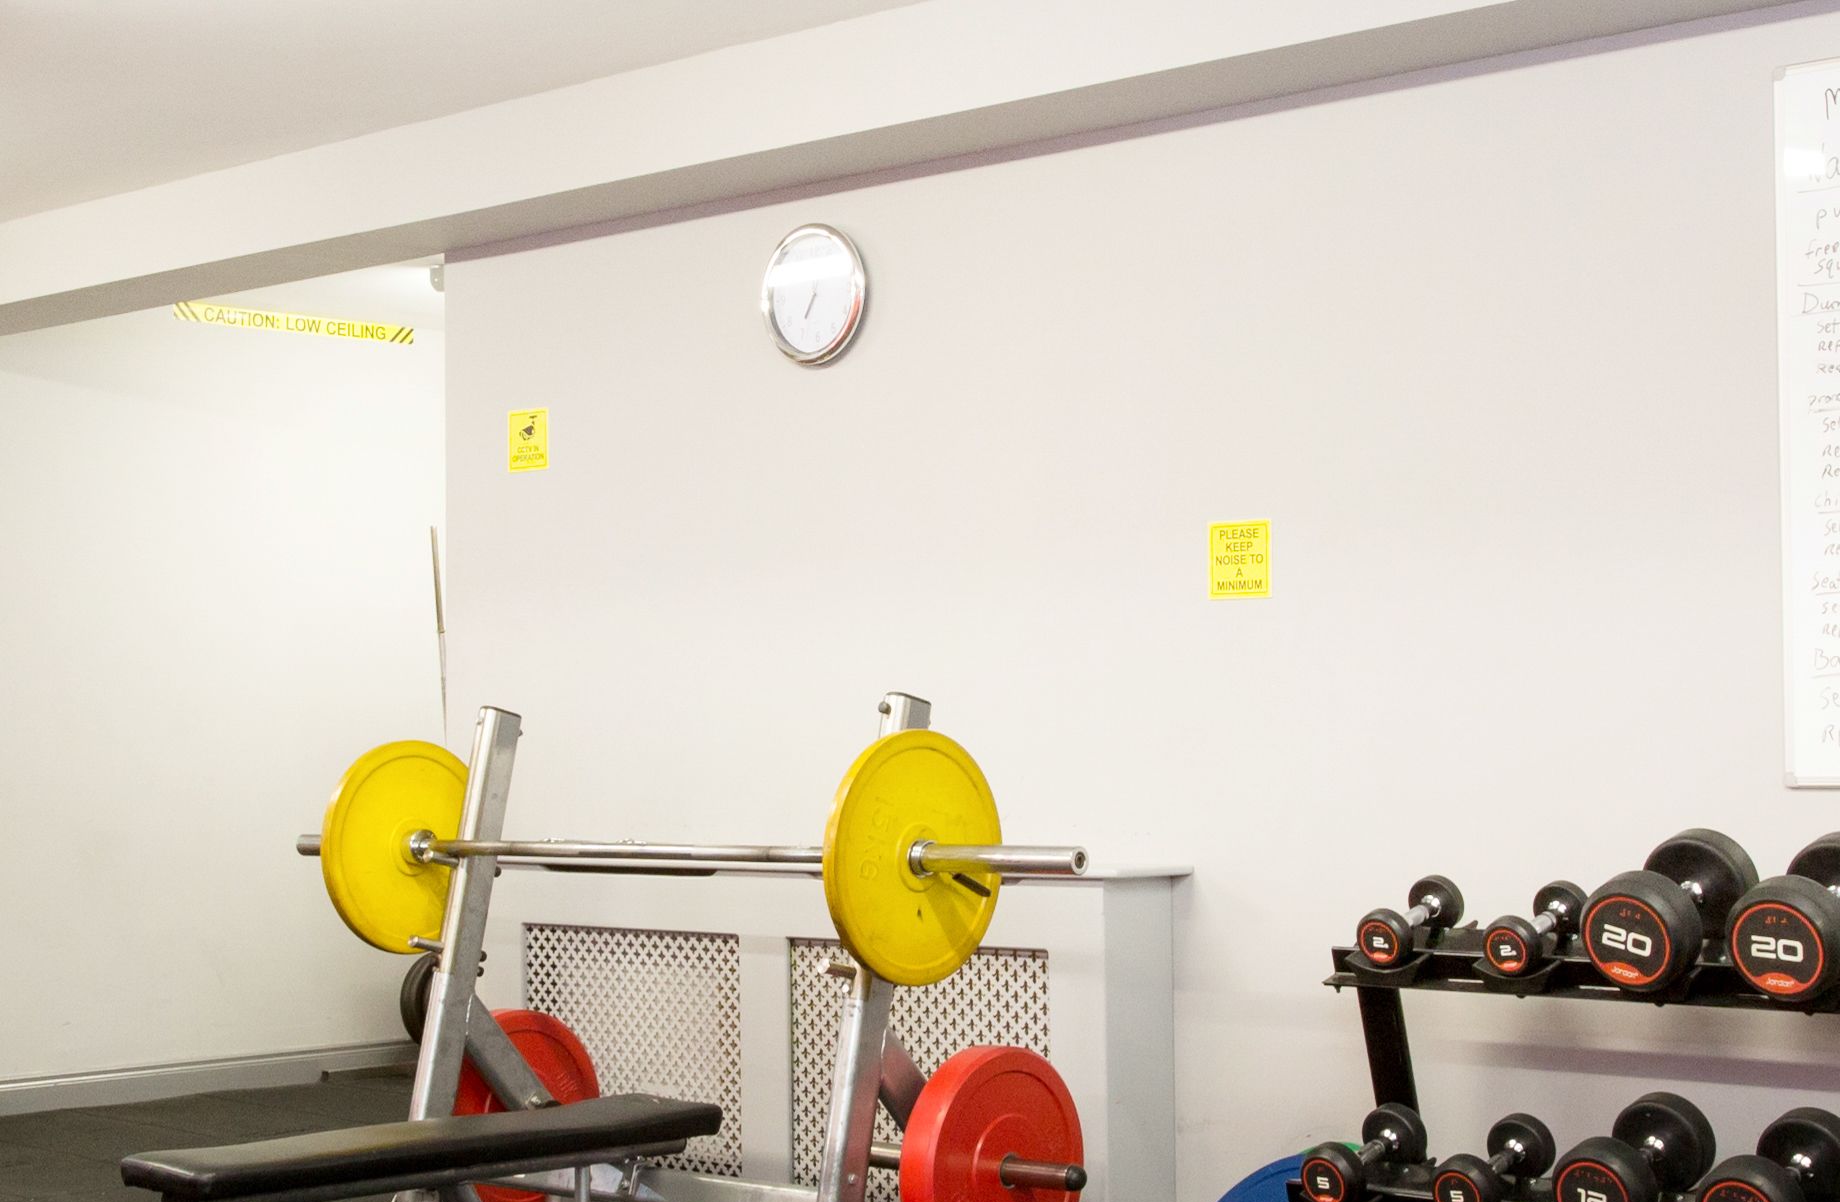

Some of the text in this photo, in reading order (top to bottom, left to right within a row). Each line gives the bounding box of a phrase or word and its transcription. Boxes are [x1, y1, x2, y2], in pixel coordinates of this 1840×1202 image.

[204, 306, 387, 341] CAUTION: LOW CEILING
[1219, 528, 1260, 540] PLEASE
[1225, 541, 1254, 553] KEEP
[1215, 553, 1264, 566] NOISE TO
[1235, 567, 1244, 578] A
[1217, 579, 1263, 591] MINIMUM
[1601, 922, 1653, 959] 20
[1750, 933, 1805, 963] 20
[1315, 1176, 1330, 1190] 5
